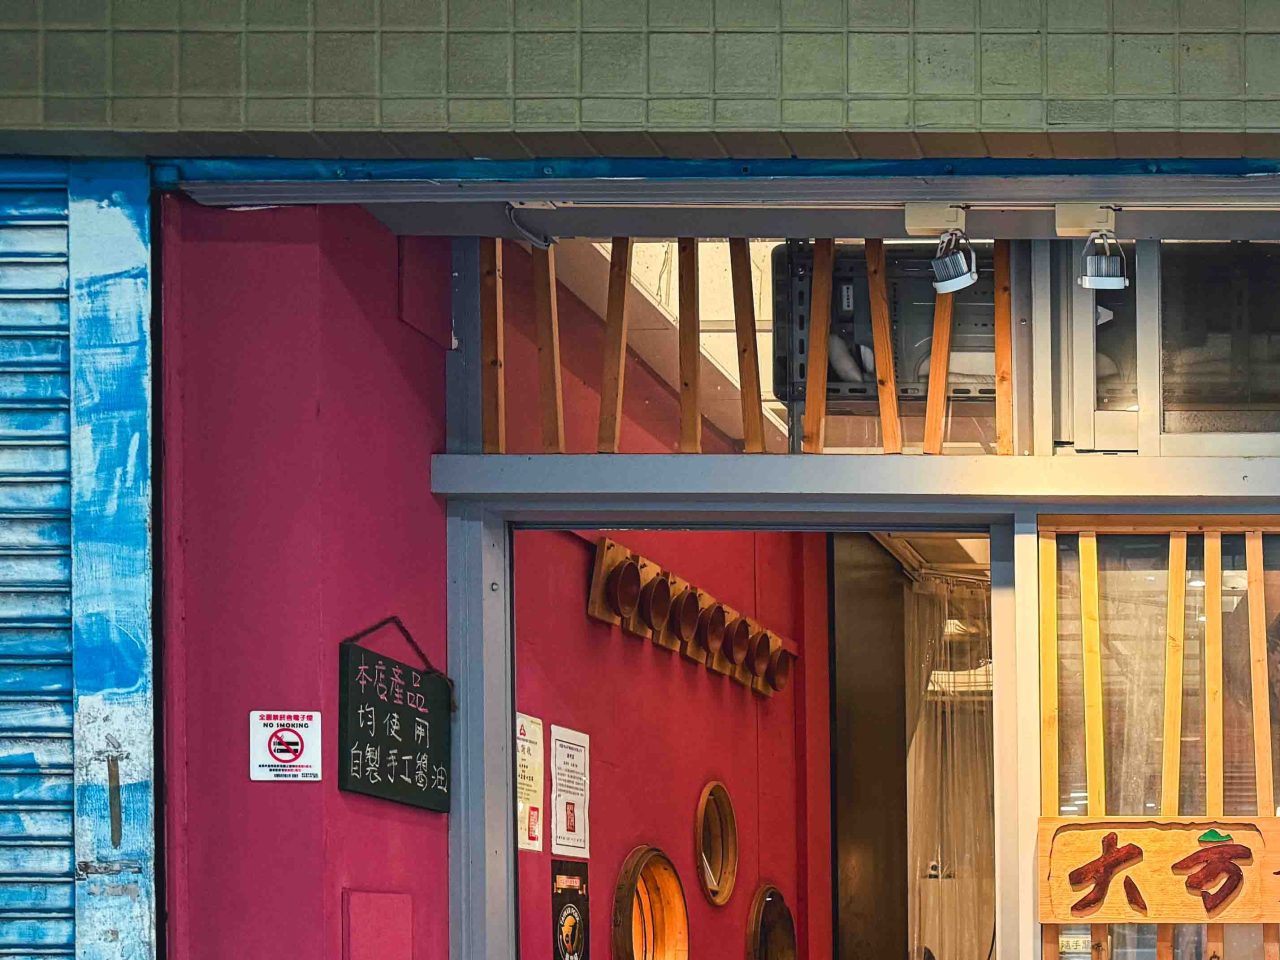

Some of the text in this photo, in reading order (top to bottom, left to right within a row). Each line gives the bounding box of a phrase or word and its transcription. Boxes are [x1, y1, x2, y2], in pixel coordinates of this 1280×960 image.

[355, 653, 430, 713] 本店產品
[357, 702, 430, 749] 均使用
